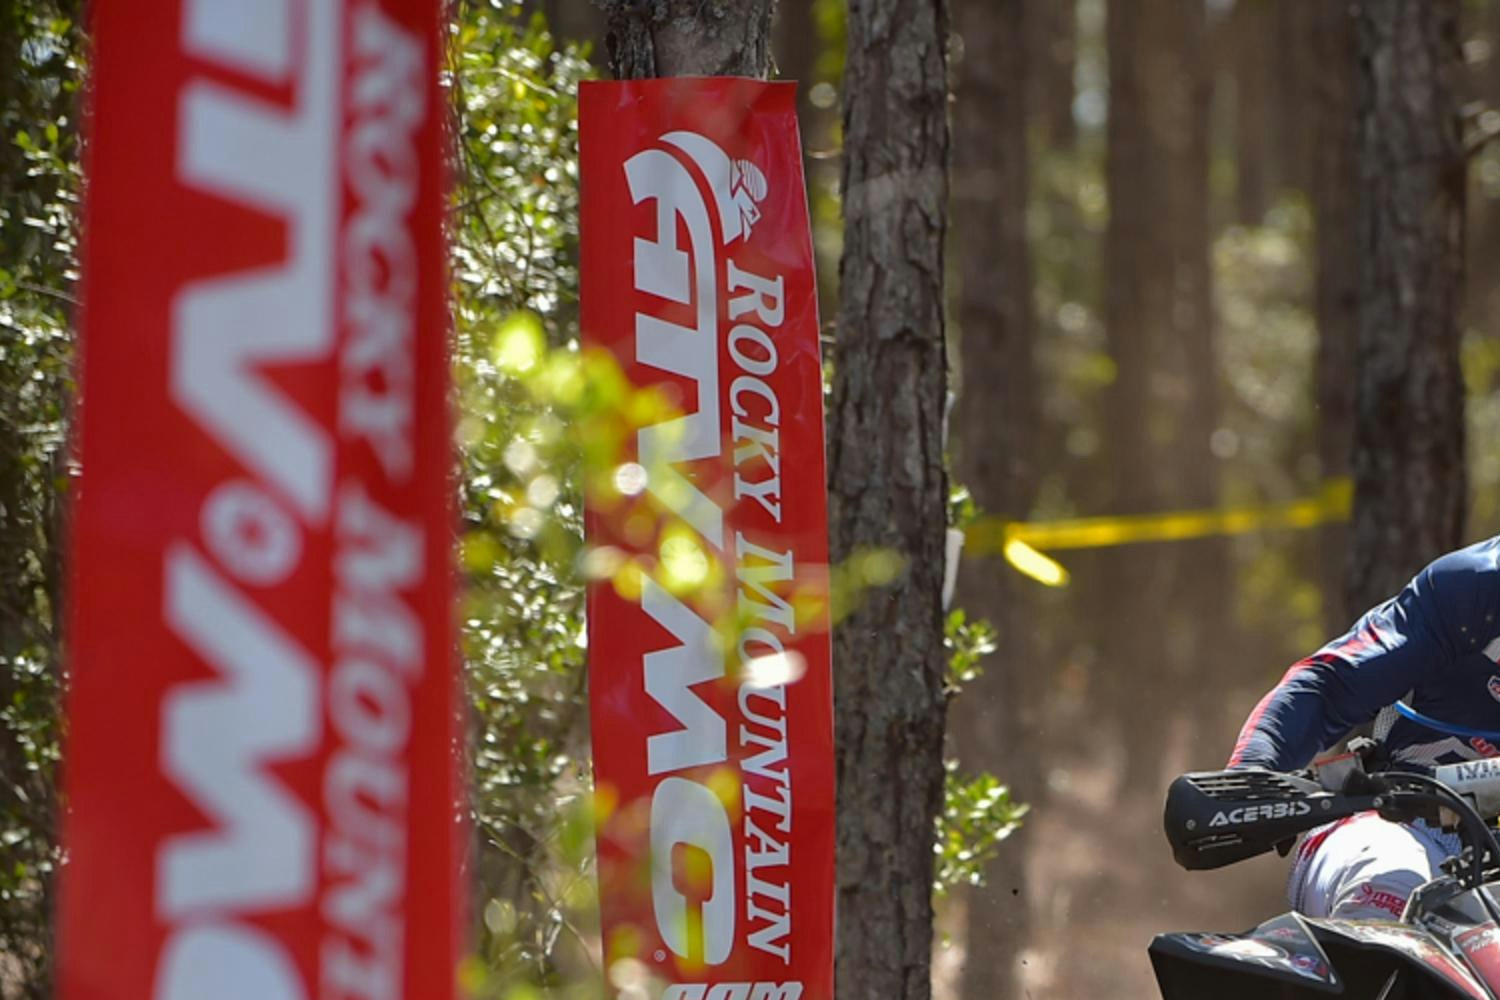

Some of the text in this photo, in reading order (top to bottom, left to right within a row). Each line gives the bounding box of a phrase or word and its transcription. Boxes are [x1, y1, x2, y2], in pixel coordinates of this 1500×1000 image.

[340, 0, 428, 485] ROCKY
[727, 258, 785, 522] ROCKY
[1208, 801, 1312, 827] ACERBIS
